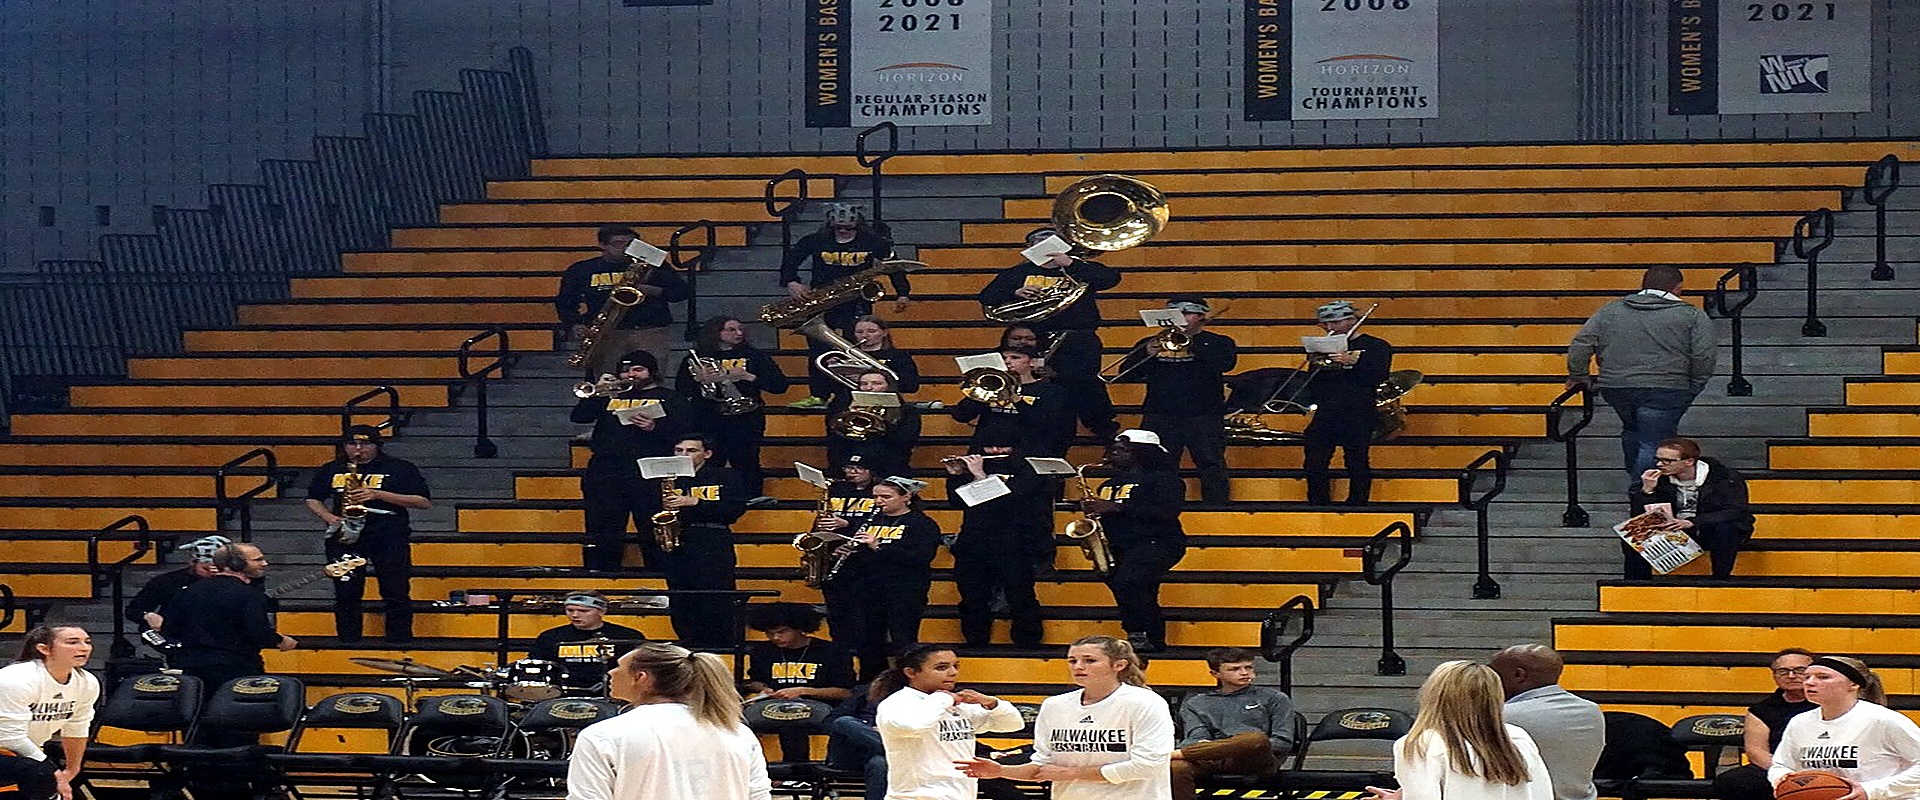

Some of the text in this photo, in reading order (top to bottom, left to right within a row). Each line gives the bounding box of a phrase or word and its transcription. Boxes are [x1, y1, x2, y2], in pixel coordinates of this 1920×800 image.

[1747, 3, 1836, 22] 2021
[878, 13, 960, 32] 2021
[1258, 23, 1278, 99] WOMEN'S
[1680, 16, 1701, 93] WOMEN'S
[819, 32, 838, 106] WOMEN'S
[1320, 64, 1410, 75] HORIZON
[878, 72, 963, 83] HORIZON
[854, 93, 988, 105] REGULAR SEASON
[1311, 86, 1419, 97] TOURNAMENT
[860, 103, 982, 117] CHAMPIONS
[1302, 95, 1429, 110] CHAMPIONS
[772, 662, 818, 680] MKE
[1050, 729, 1127, 743] MILWAUKEE
